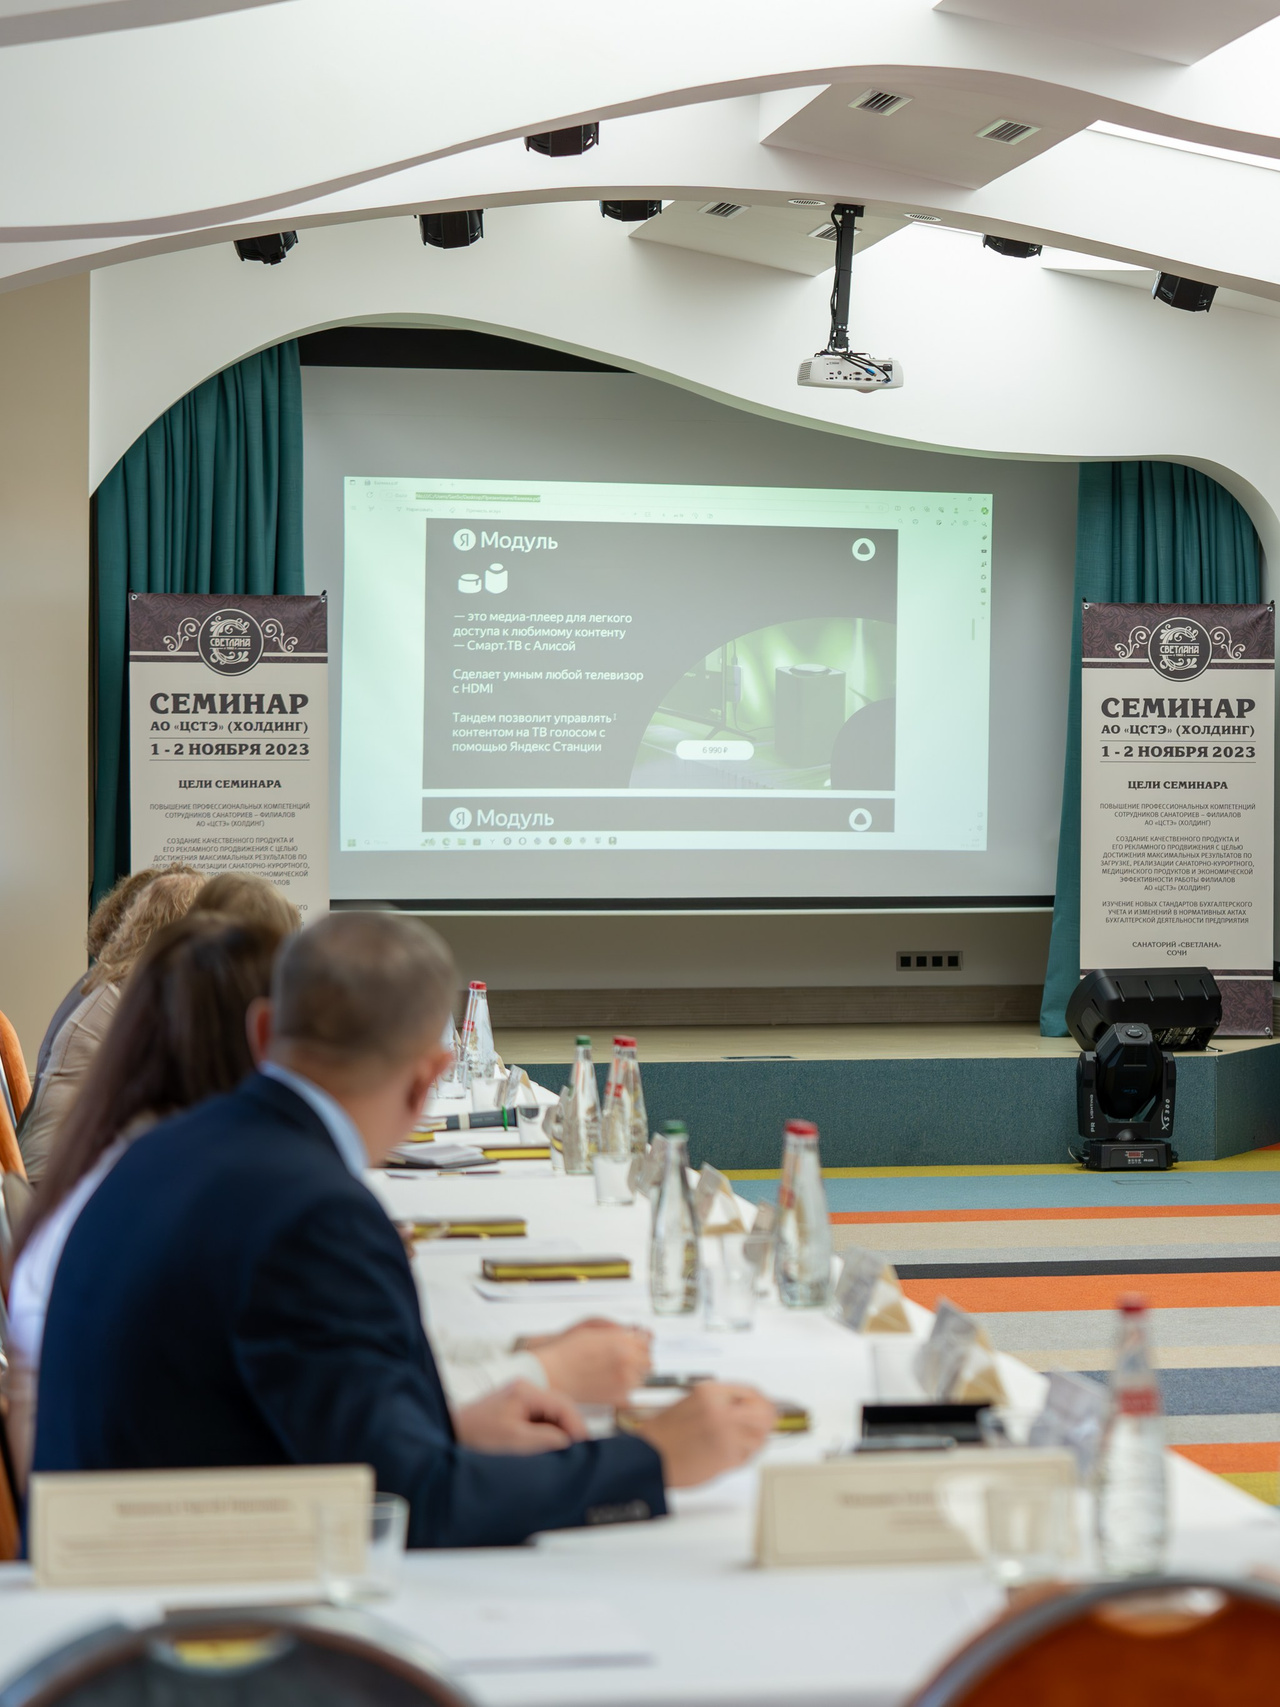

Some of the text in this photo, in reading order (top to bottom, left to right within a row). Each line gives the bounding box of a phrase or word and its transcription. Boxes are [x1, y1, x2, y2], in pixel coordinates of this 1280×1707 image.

[480, 531, 559, 553] Модуль
[468, 613, 487, 621] это
[489, 613, 564, 624] медиа-плеер
[565, 614, 586, 624] для
[588, 614, 632, 623] легкого
[453, 626, 626, 640] доступа к любимому контенту
[210, 638, 251, 647] СВЕТЛАНА
[467, 640, 522, 652] Смарт.ТВ
[524, 643, 531, 651] с
[533, 640, 576, 651] Алисой
[1160, 645, 1199, 654] СВЕТЛАНА
[453, 669, 644, 682] Сделает умным любой телевизор
[453, 683, 493, 694] с HDMI
[150, 692, 309, 714] СЕМИНАР
[1101, 697, 1256, 718] СЕМИНАР
[452, 712, 612, 725] Тандем позволит управлять
[150, 721, 170, 731] АО
[1101, 725, 1121, 734] АО
[452, 727, 606, 738] контентом на ТВ голосом с
[151, 743, 159, 755] 1
[174, 743, 184, 755] 2
[189, 743, 261, 755] НОЯБРЯ
[265, 743, 309, 755] 2023
[452, 741, 602, 753] помощью Яндекс Станции
[1102, 746, 1109, 757] 1
[1124, 746, 1133, 757] 2
[1138, 746, 1208, 758] НОЯБРЯ
[1212, 746, 1256, 758] 2023
[179, 780, 282, 790] ЦЕЛИ СЕМИНАРА
[1128, 781, 1228, 790] ЦЕЛИ СЕМИНАРА
[1210, 803, 1256, 811] КОМПЕТЕНЦИЙ
[477, 809, 555, 830] Модуль
[166, 837, 201, 845] СОЗДАНИЕ
[219, 845, 269, 853] ПРОДВИЖЕНИЯ
[275, 845, 298, 853] ЦЕЛЬЮ
[1205, 917, 1249, 925] ПРЕДПРИЯТИЯ
